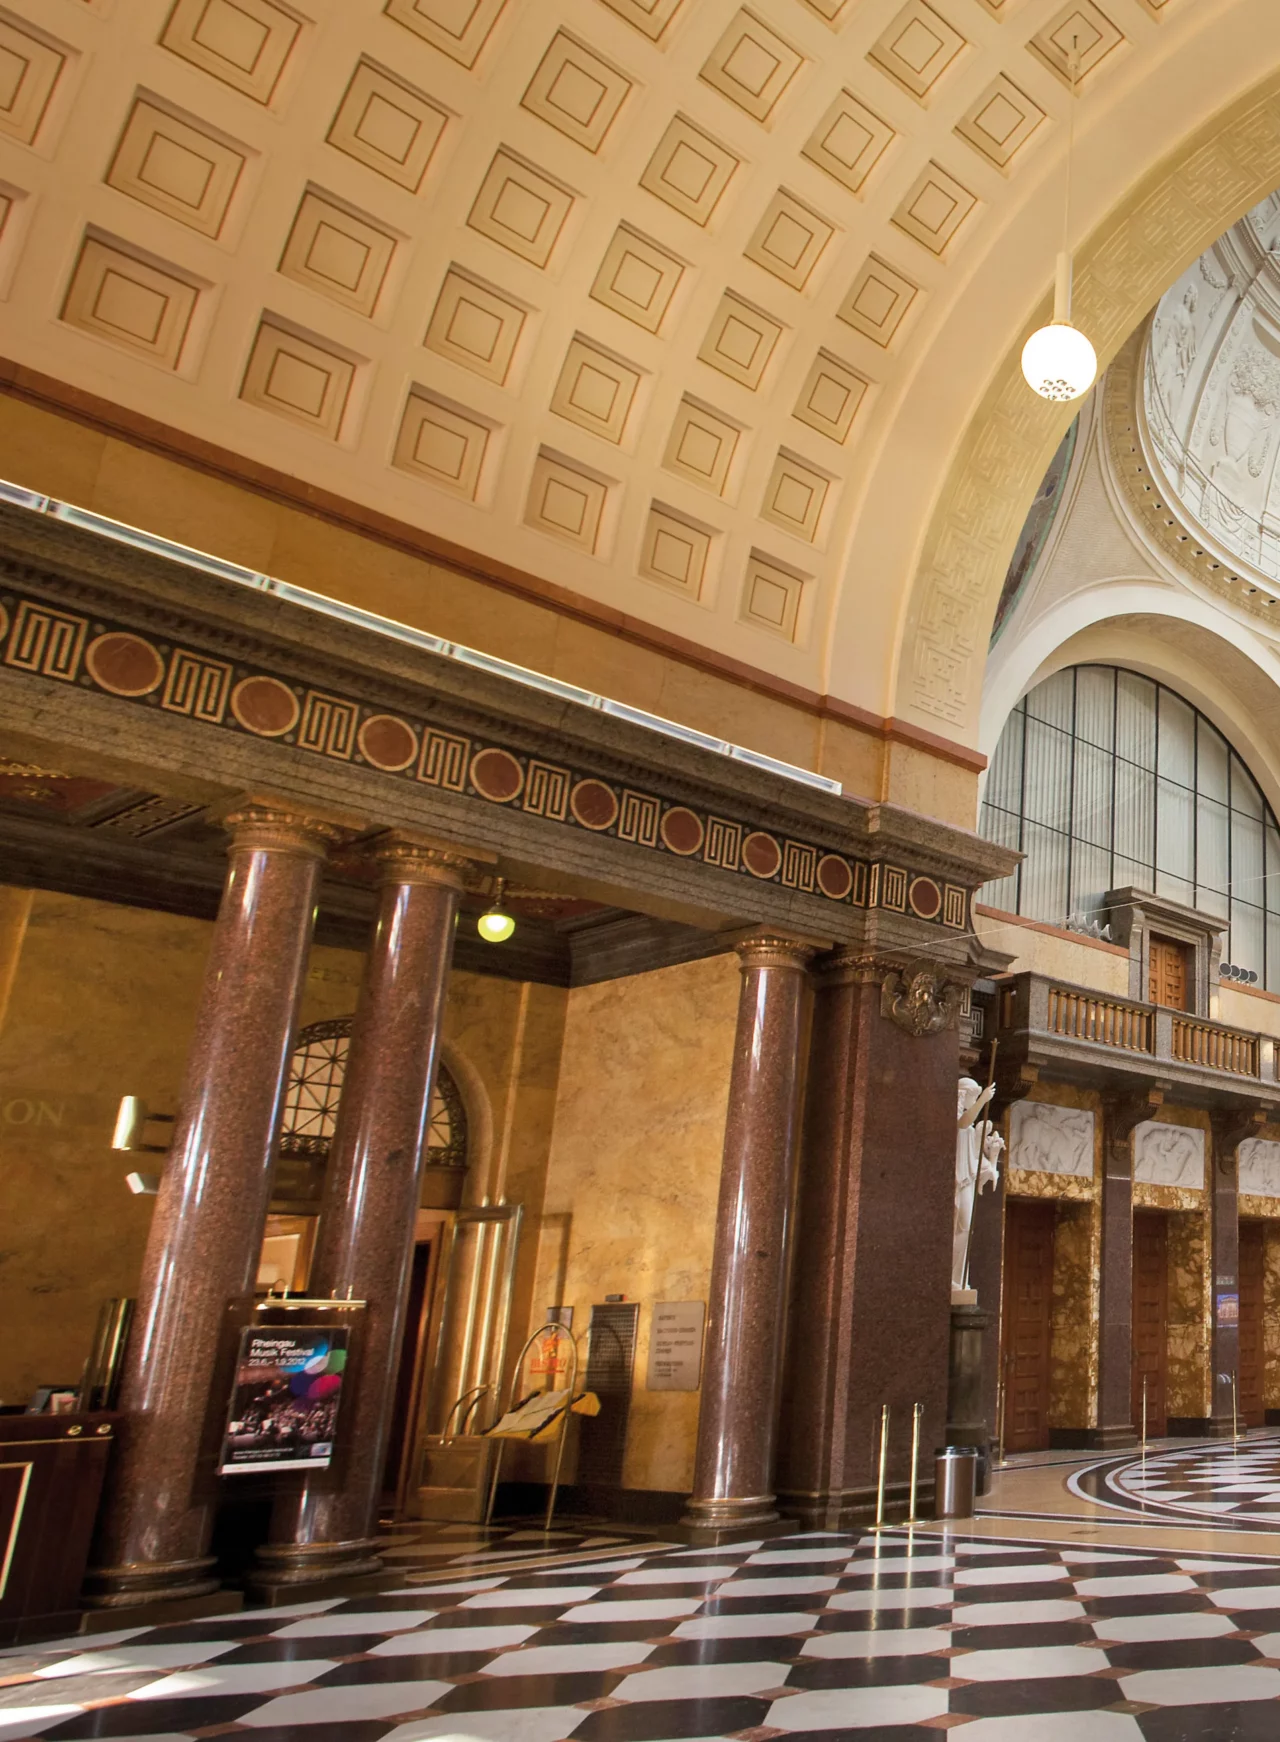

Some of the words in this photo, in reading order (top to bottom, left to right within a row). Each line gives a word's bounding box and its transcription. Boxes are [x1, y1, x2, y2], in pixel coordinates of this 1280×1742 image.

[252, 1339, 296, 1349] Rheingau
[249, 1348, 278, 1357] Musik
[280, 1347, 315, 1357] Festival
